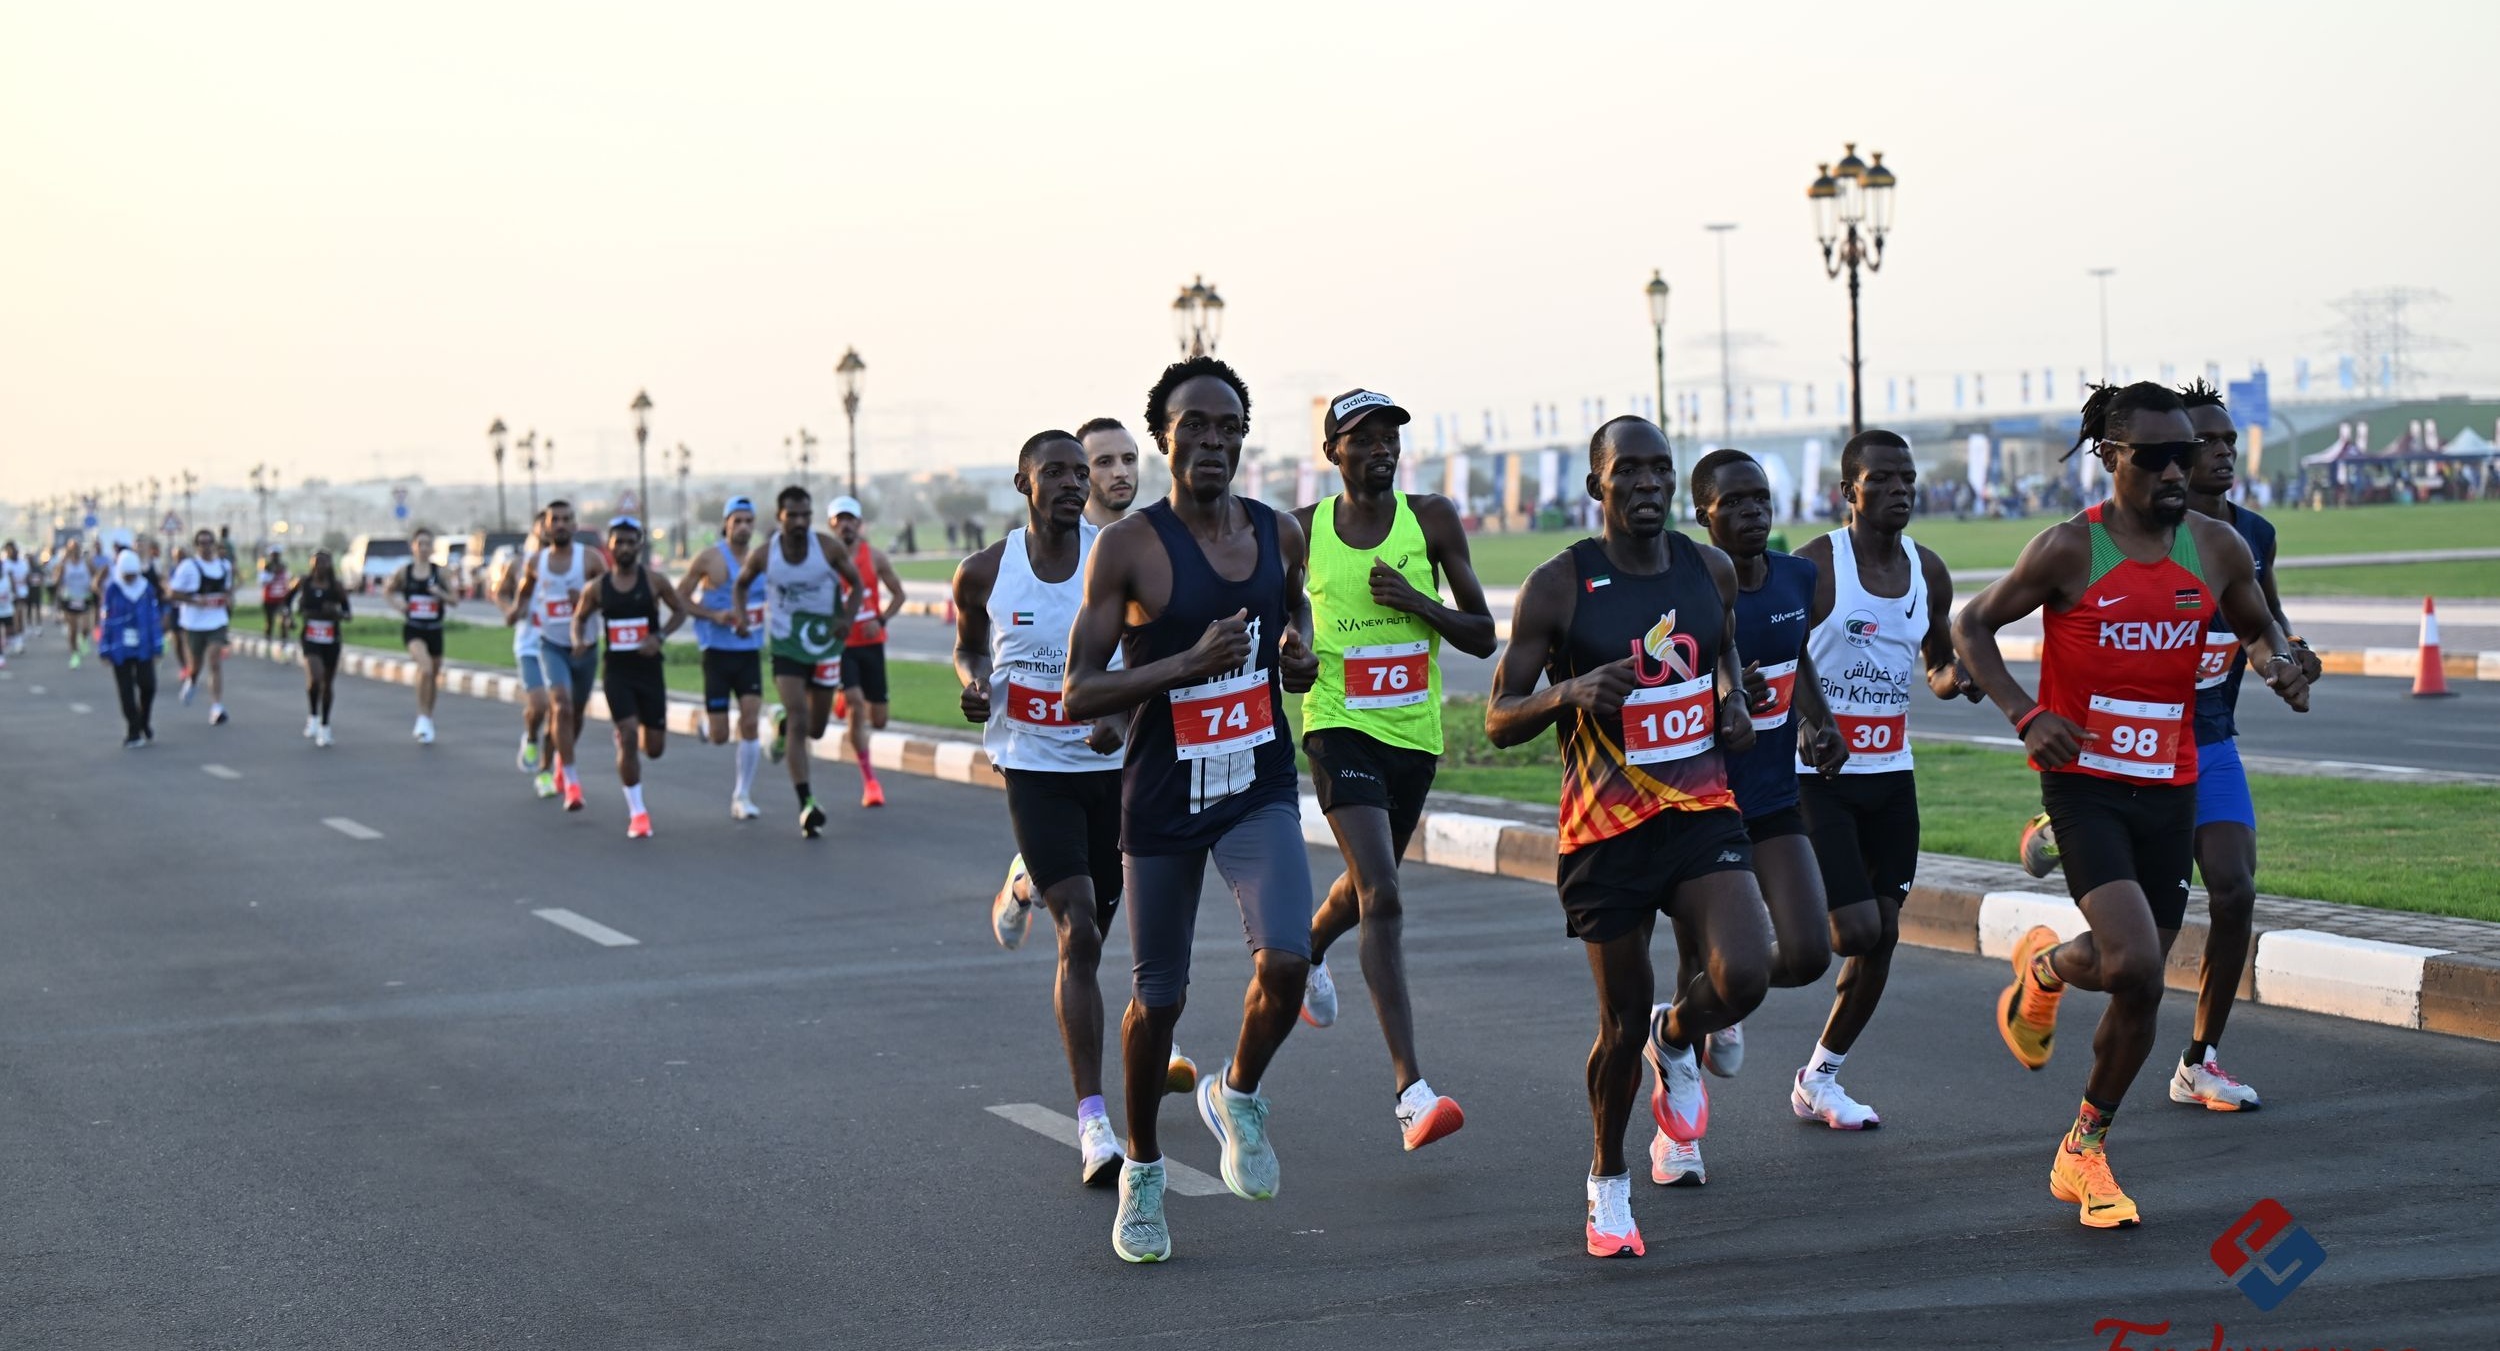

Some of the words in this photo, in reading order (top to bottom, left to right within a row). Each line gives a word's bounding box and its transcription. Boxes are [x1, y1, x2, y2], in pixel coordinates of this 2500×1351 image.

[1361, 619, 1384, 628] NEW
[1387, 616, 1411, 625] AUTO
[2098, 620, 2200, 651] KENYA
[1035, 661, 1066, 674] Khar
[1368, 665, 1409, 691] 76
[1028, 697, 1064, 722] 31
[1201, 701, 1249, 736] 74
[1641, 704, 1705, 742] 102
[1852, 724, 1891, 749] 30
[2110, 725, 2159, 757] 98
